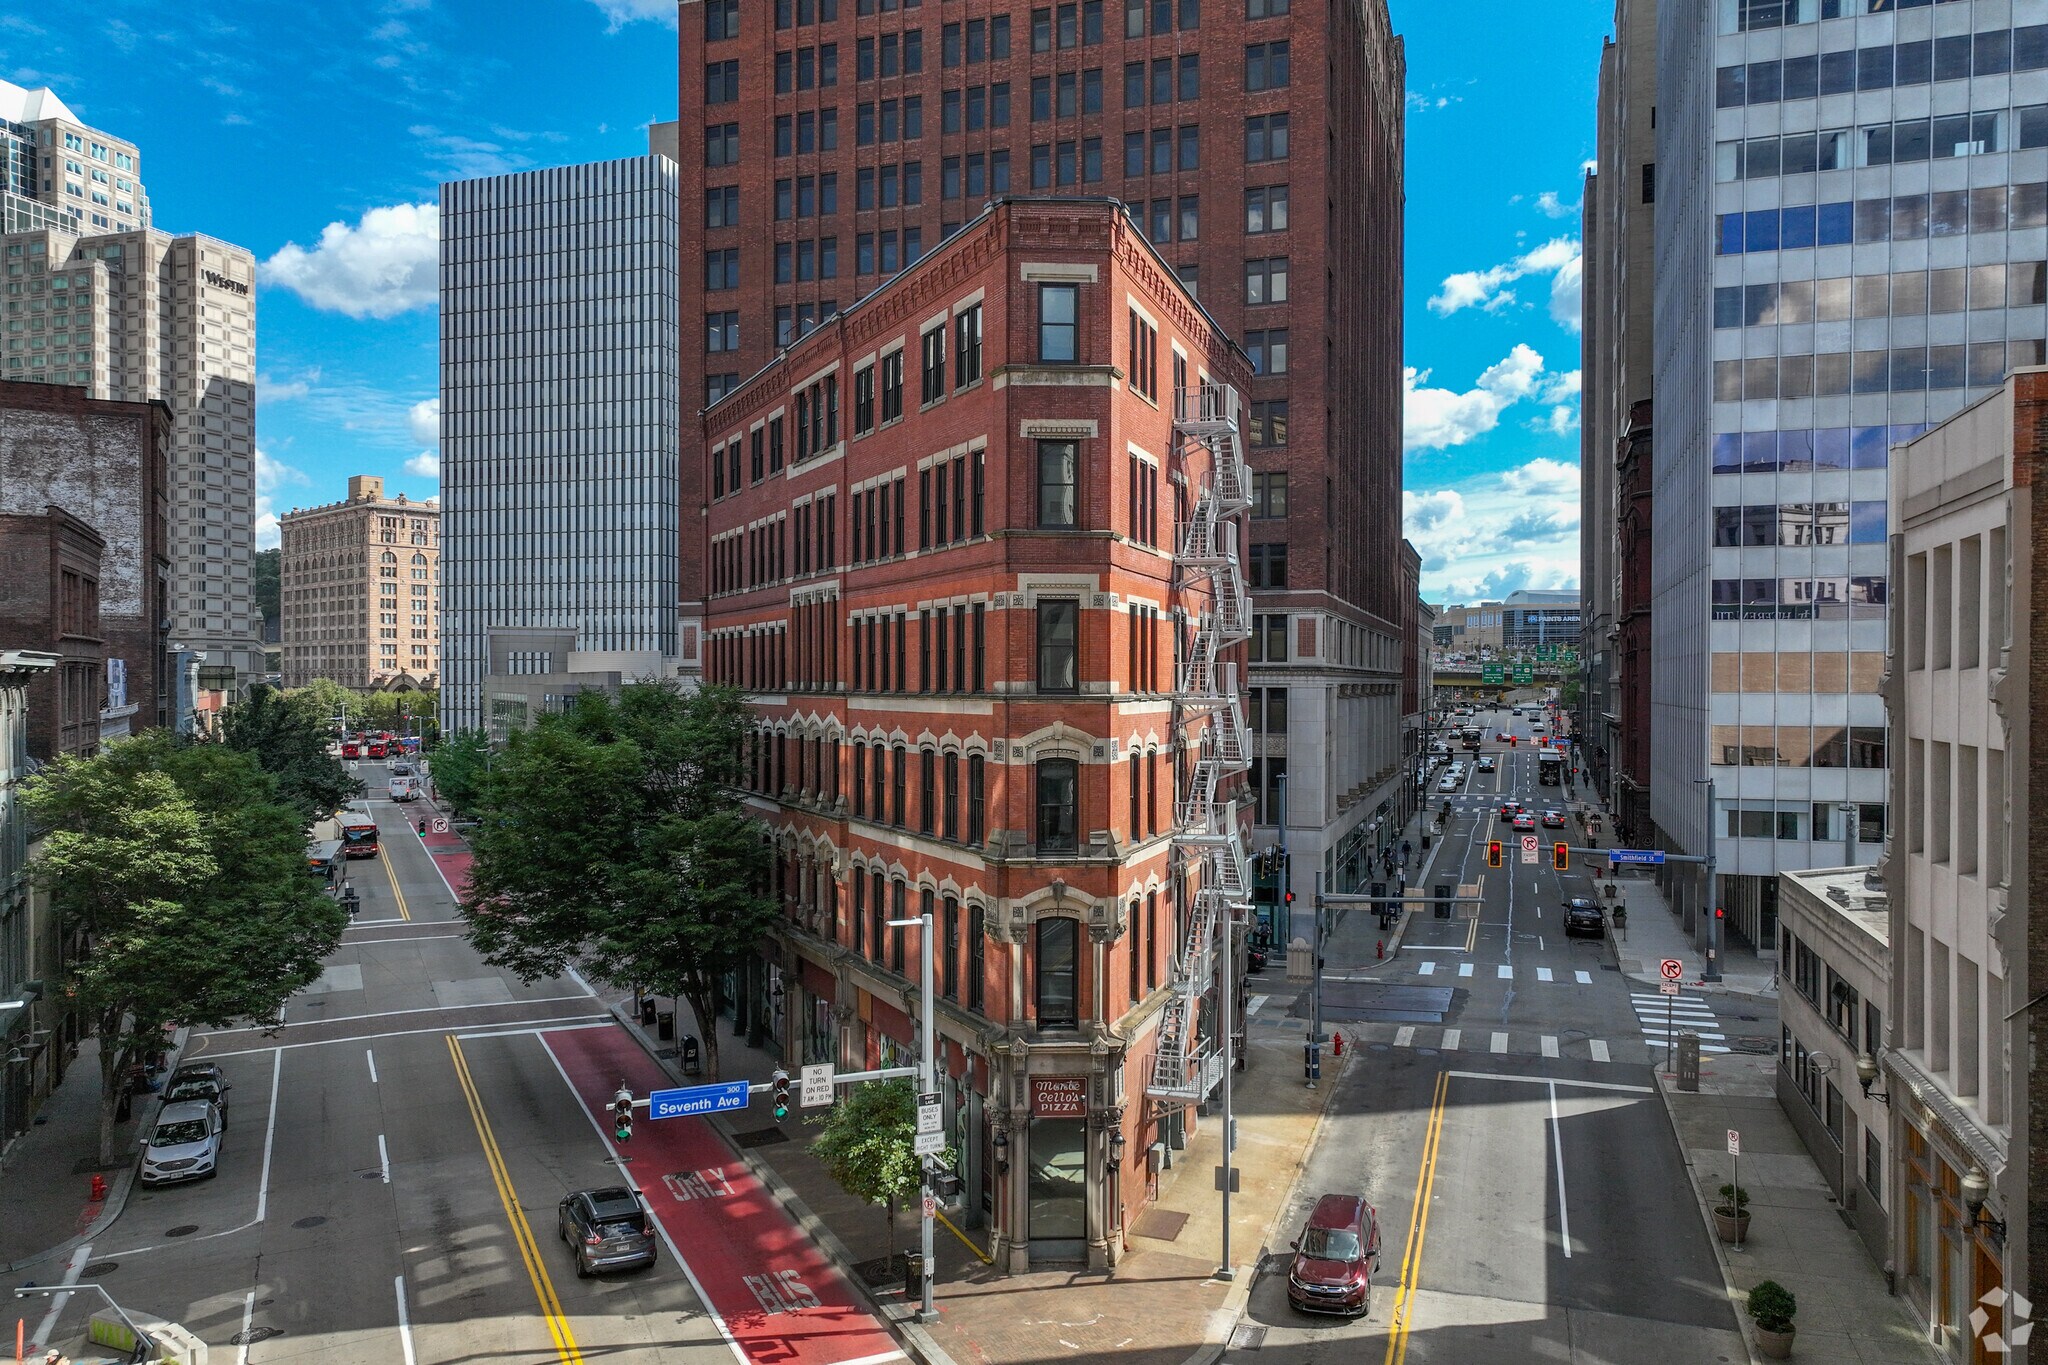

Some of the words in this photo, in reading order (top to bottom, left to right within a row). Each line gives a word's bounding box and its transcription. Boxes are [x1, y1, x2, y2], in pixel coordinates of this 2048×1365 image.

[205, 270, 248, 295] WESTIN
[1619, 854, 1647, 862] Smithfield
[727, 1086, 740, 1094] 300
[805, 1086, 816, 1094] ON
[816, 1085, 830, 1093] RED
[1038, 1092, 1079, 1103] Cello's
[659, 1098, 711, 1114] Seventh
[717, 1096, 740, 1107] Ave
[1041, 1103, 1078, 1111] PIZZA
[921, 1106, 939, 1114] BUSES
[922, 1113, 937, 1121] ONLY
[921, 1136, 939, 1144] EXCEPT
[662, 1167, 735, 1201] ONLY
[742, 1269, 822, 1315] BUS
